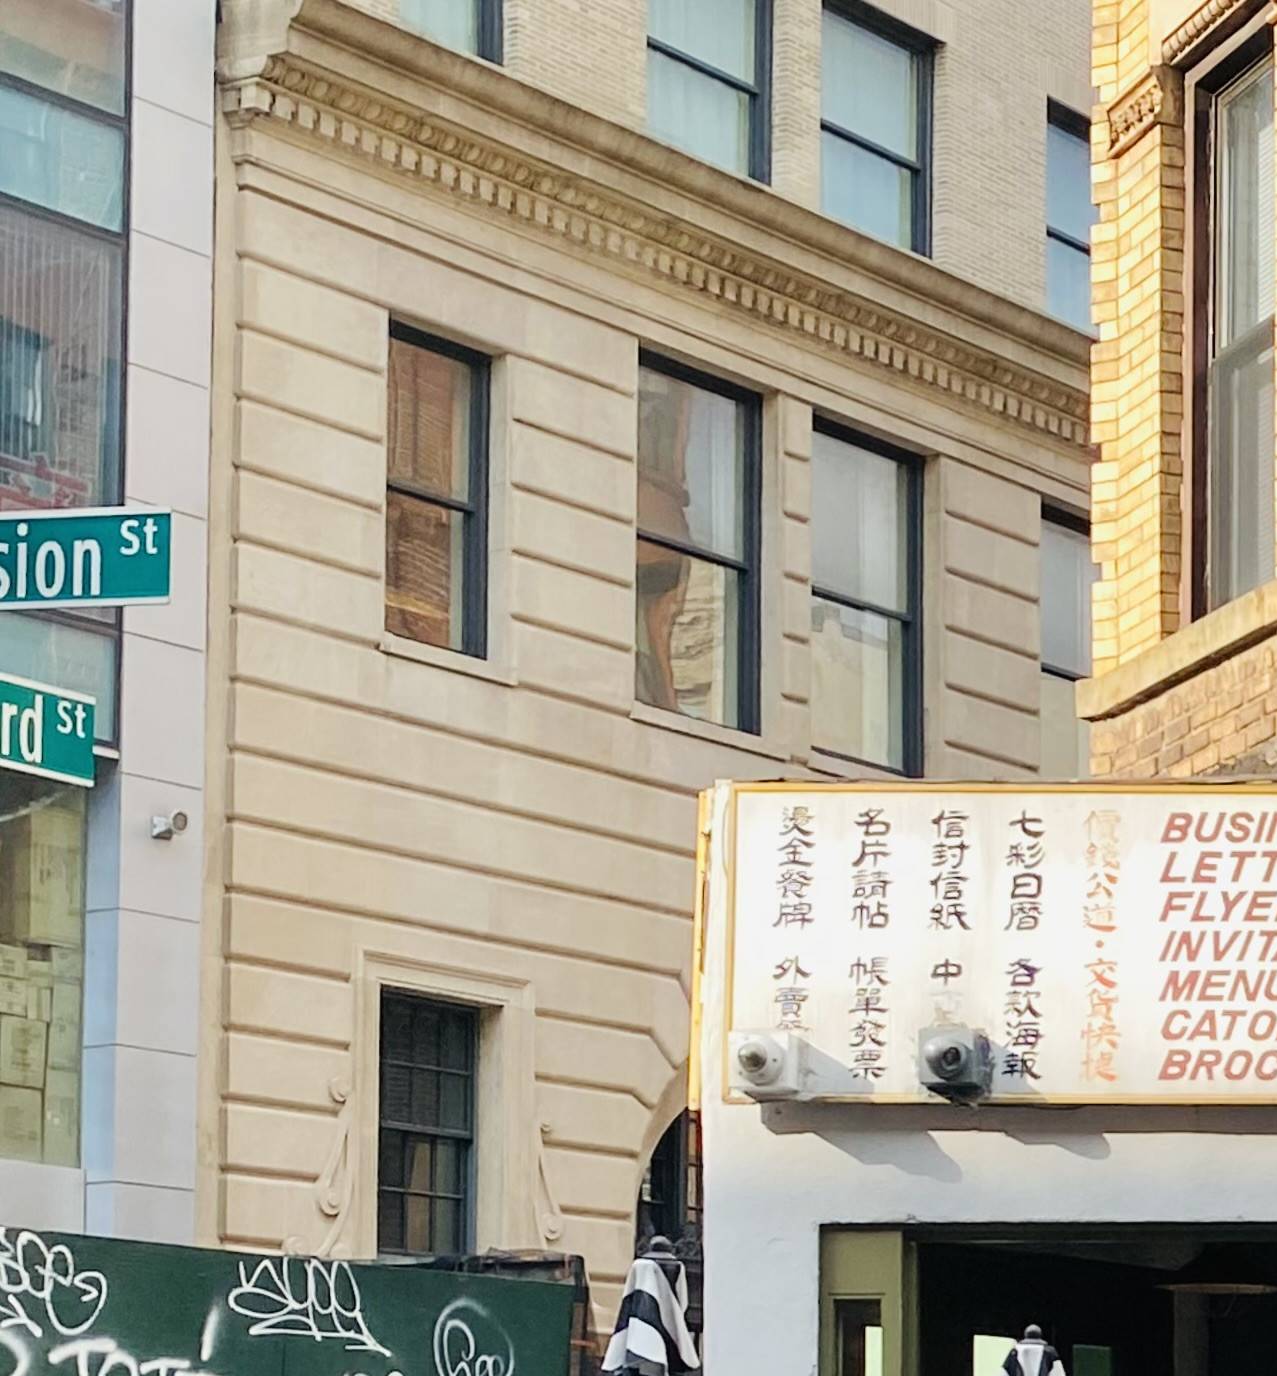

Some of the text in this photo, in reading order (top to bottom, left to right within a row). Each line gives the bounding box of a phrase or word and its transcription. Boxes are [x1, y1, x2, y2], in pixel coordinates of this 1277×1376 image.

[119, 518, 158, 556] St
[56, 700, 87, 739] St
[850, 807, 893, 932] 名片請帖
[929, 809, 972, 931] 信封信紙
